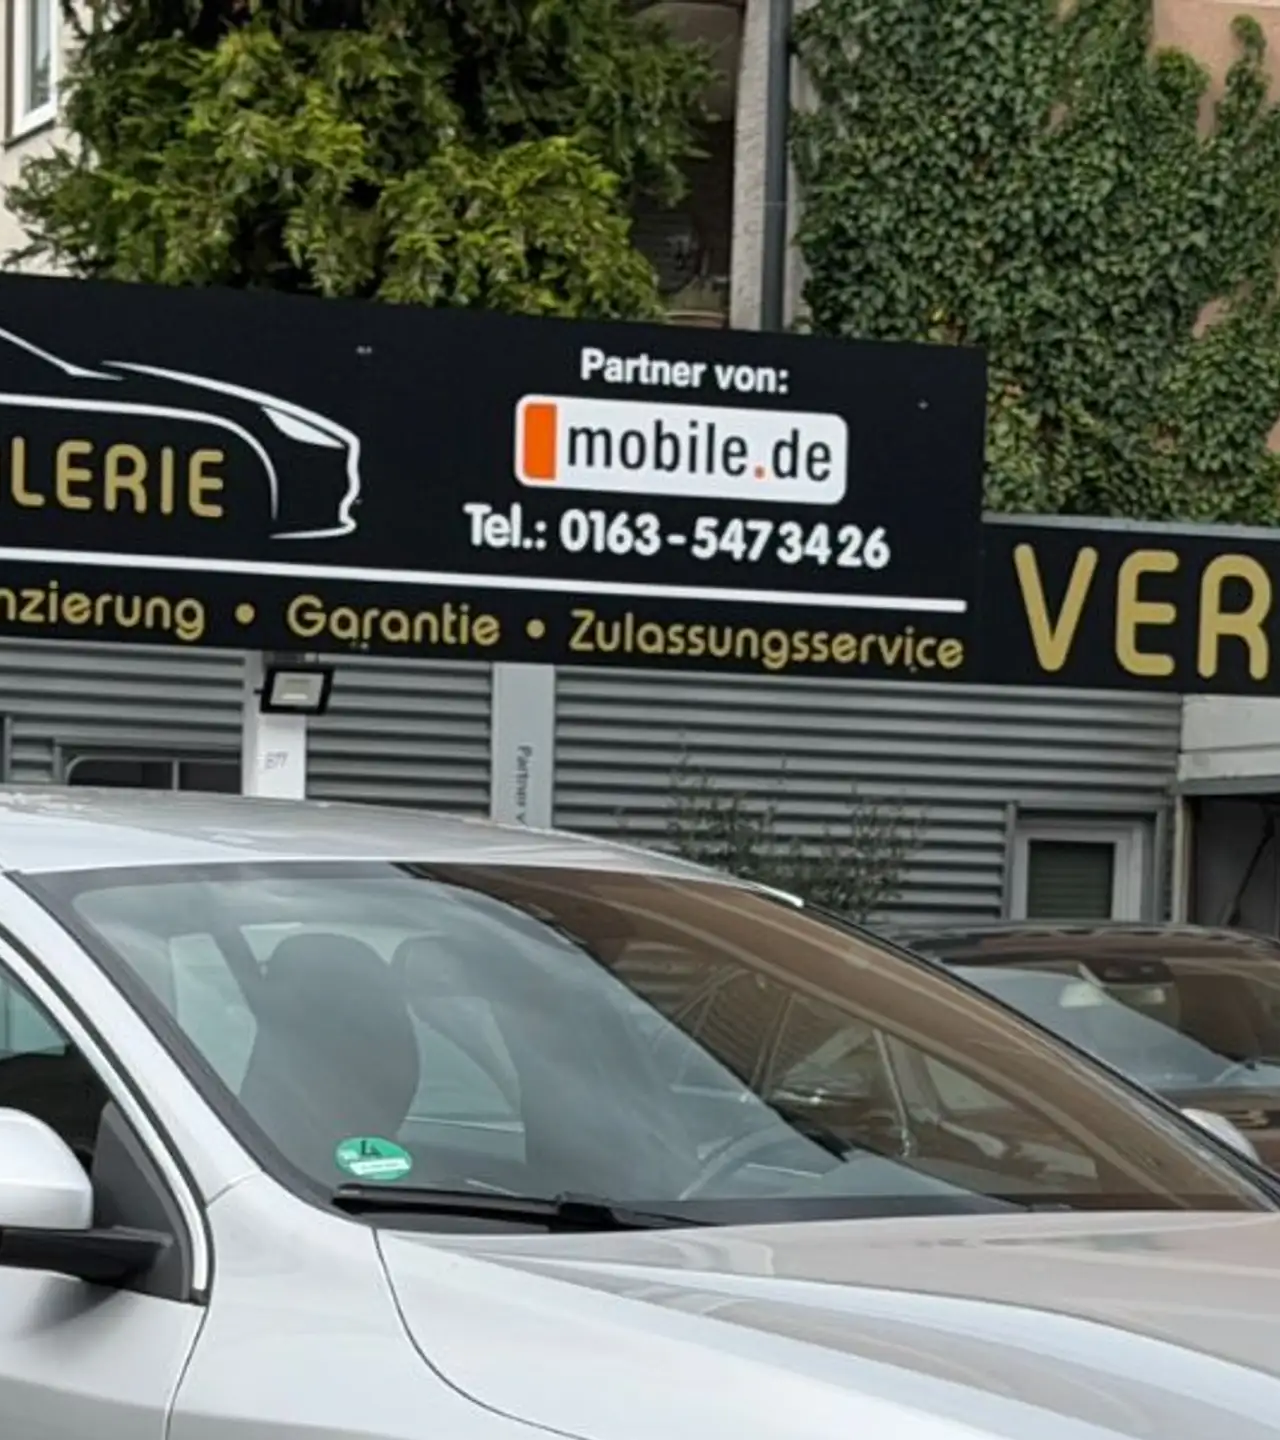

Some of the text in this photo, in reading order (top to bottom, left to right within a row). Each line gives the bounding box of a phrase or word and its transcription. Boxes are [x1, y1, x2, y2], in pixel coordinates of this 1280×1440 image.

[581, 347, 789, 394] Partner von:
[567, 419, 831, 483] mobile.de
[463, 501, 547, 551] Tel.:
[287, 596, 501, 646] Garantie
[568, 608, 964, 670] Zulassungsservice
